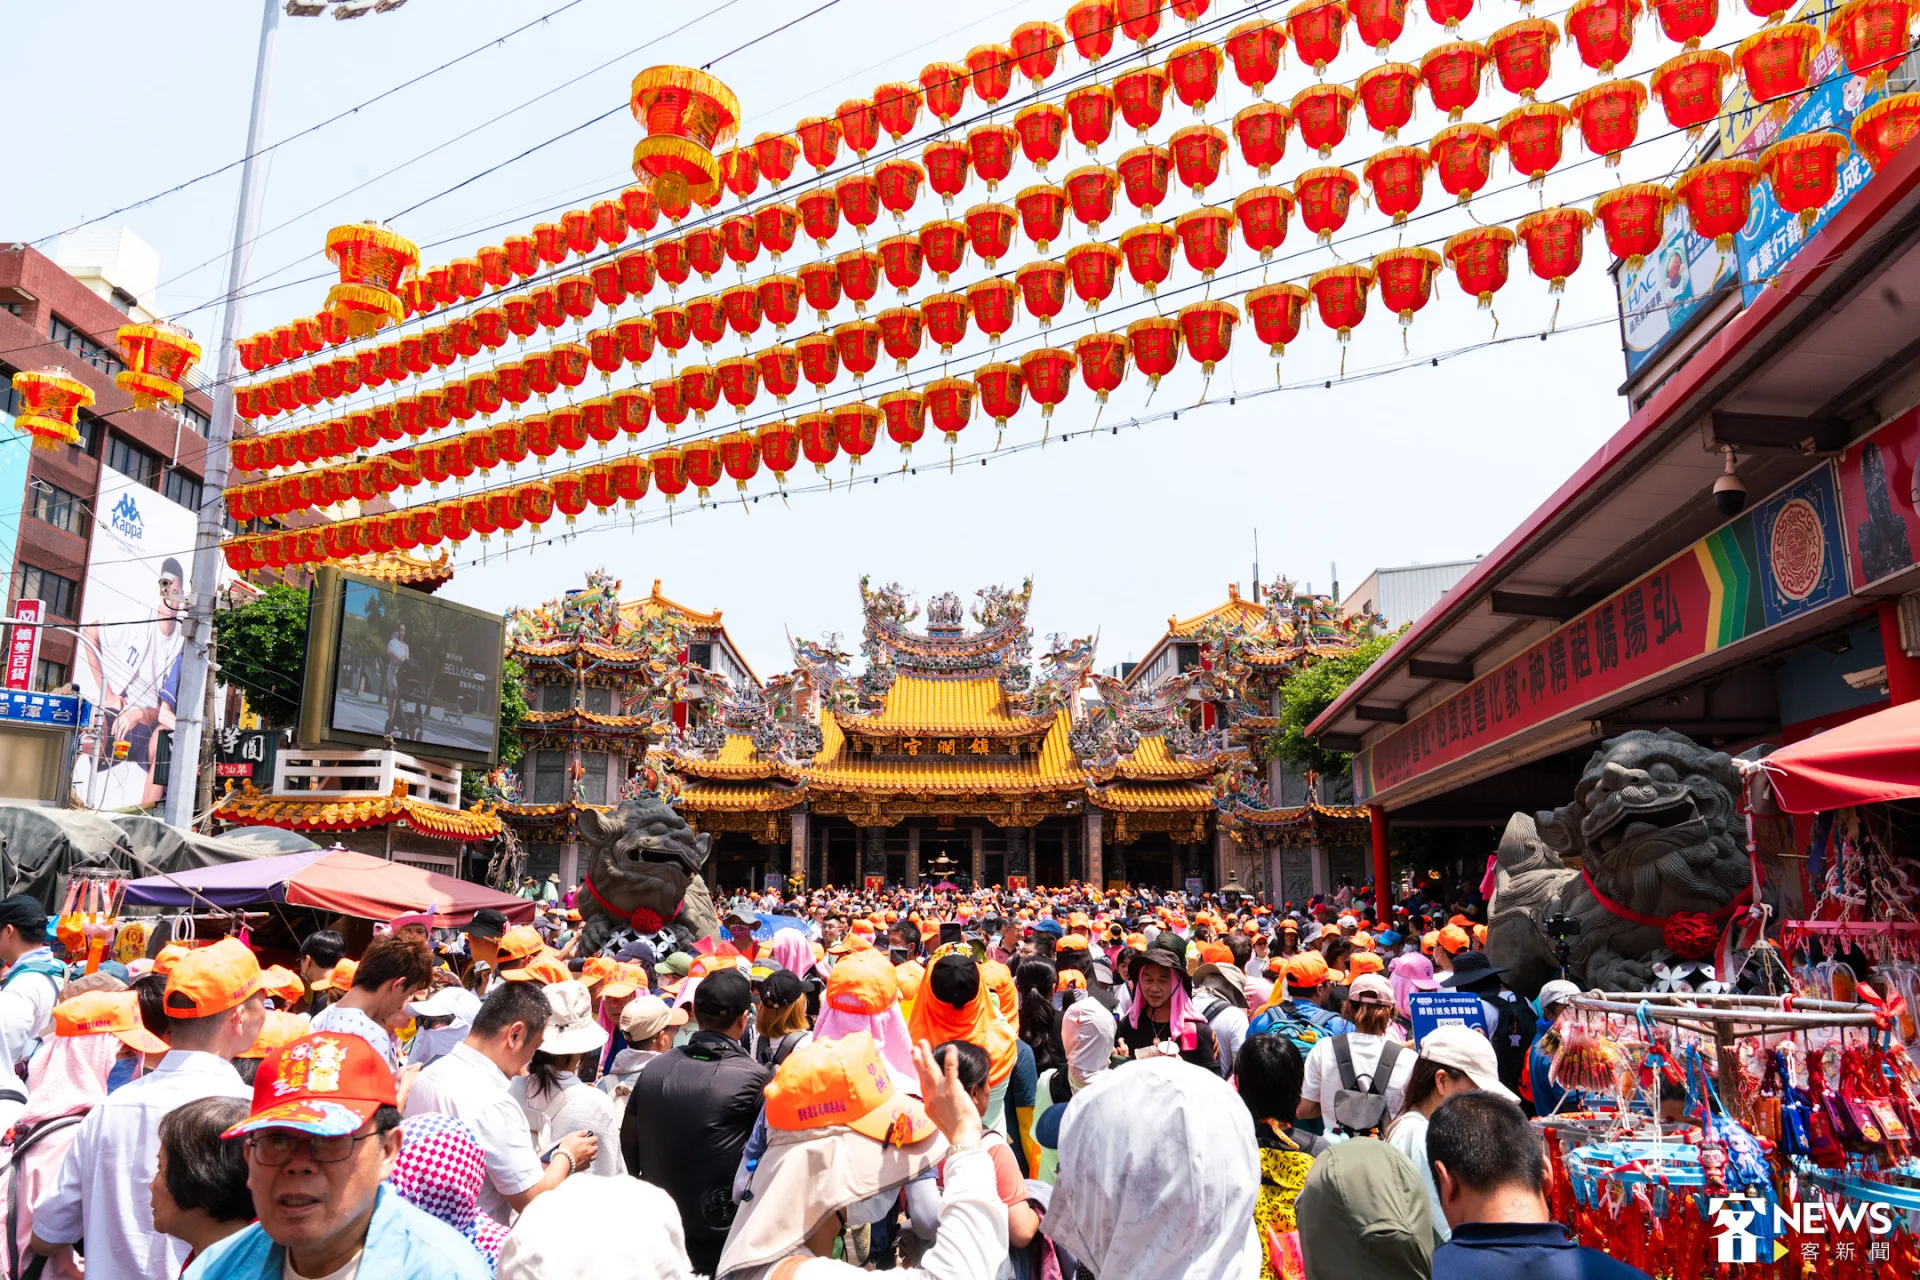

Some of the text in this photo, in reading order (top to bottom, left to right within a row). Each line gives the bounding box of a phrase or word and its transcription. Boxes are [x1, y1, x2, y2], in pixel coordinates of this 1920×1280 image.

[112, 513, 142, 539] Kappa
[223, 727, 266, 762] 芋圓
[903, 737, 990, 756] 鎮瀾宮
